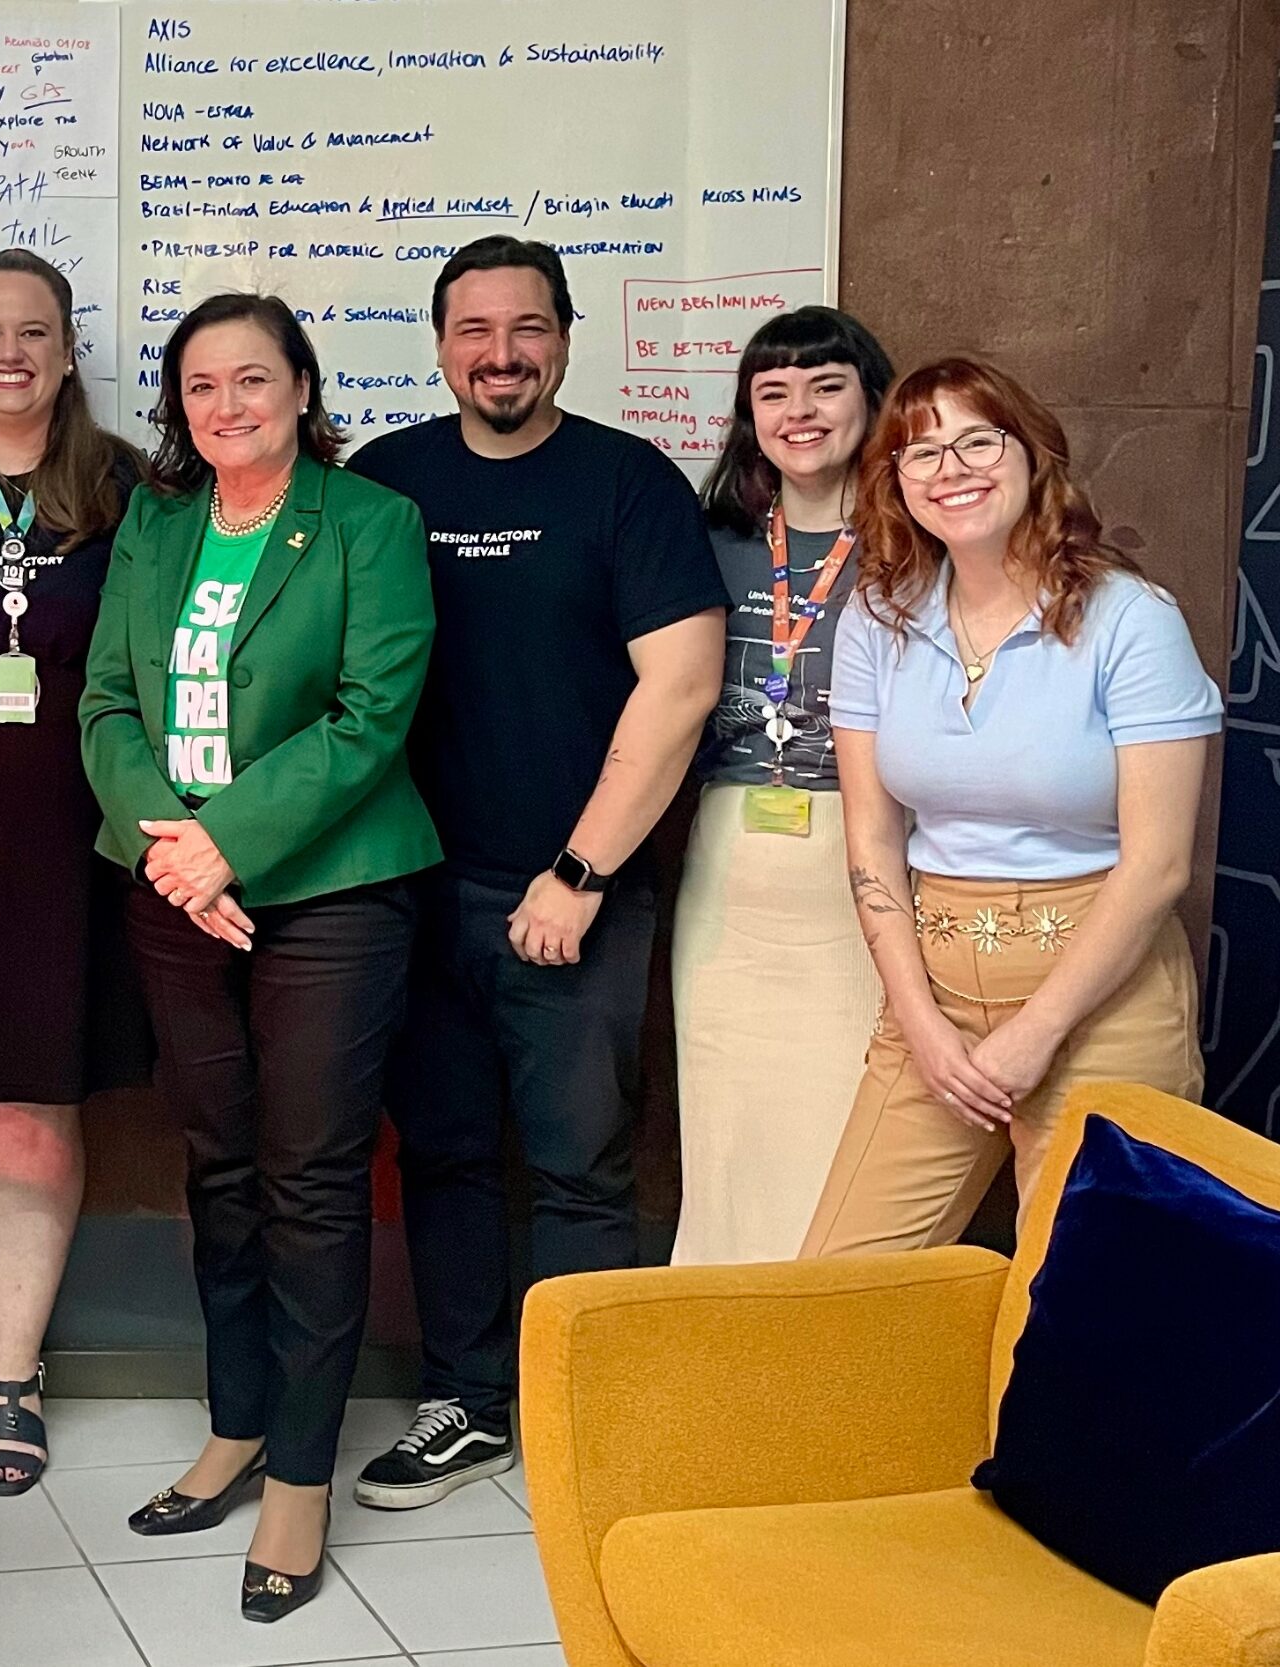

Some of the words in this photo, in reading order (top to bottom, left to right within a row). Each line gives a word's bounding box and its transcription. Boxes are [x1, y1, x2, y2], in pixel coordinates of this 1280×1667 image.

[148, 19, 191, 42] AXIS
[145, 53, 218, 73] Alliance
[143, 102, 184, 122] NOVA
[140, 174, 187, 191] BEAM
[382, 197, 434, 217] Applied
[269, 244, 297, 258] FOR
[308, 243, 383, 259] ACADEMIC
[549, 241, 663, 256] RANSFORMATION
[143, 279, 181, 295] RISE
[637, 297, 674, 312] NEW
[141, 305, 186, 322] Resea
[637, 340, 658, 357] BE
[674, 340, 741, 357] BETTER
[139, 370, 160, 387] All
[361, 409, 376, 424] &
[430, 531, 479, 543] DESIGN
[483, 530, 542, 543] FACTORY
[457, 545, 510, 557] FEEVALE
[22, 556, 64, 567] CTORY
